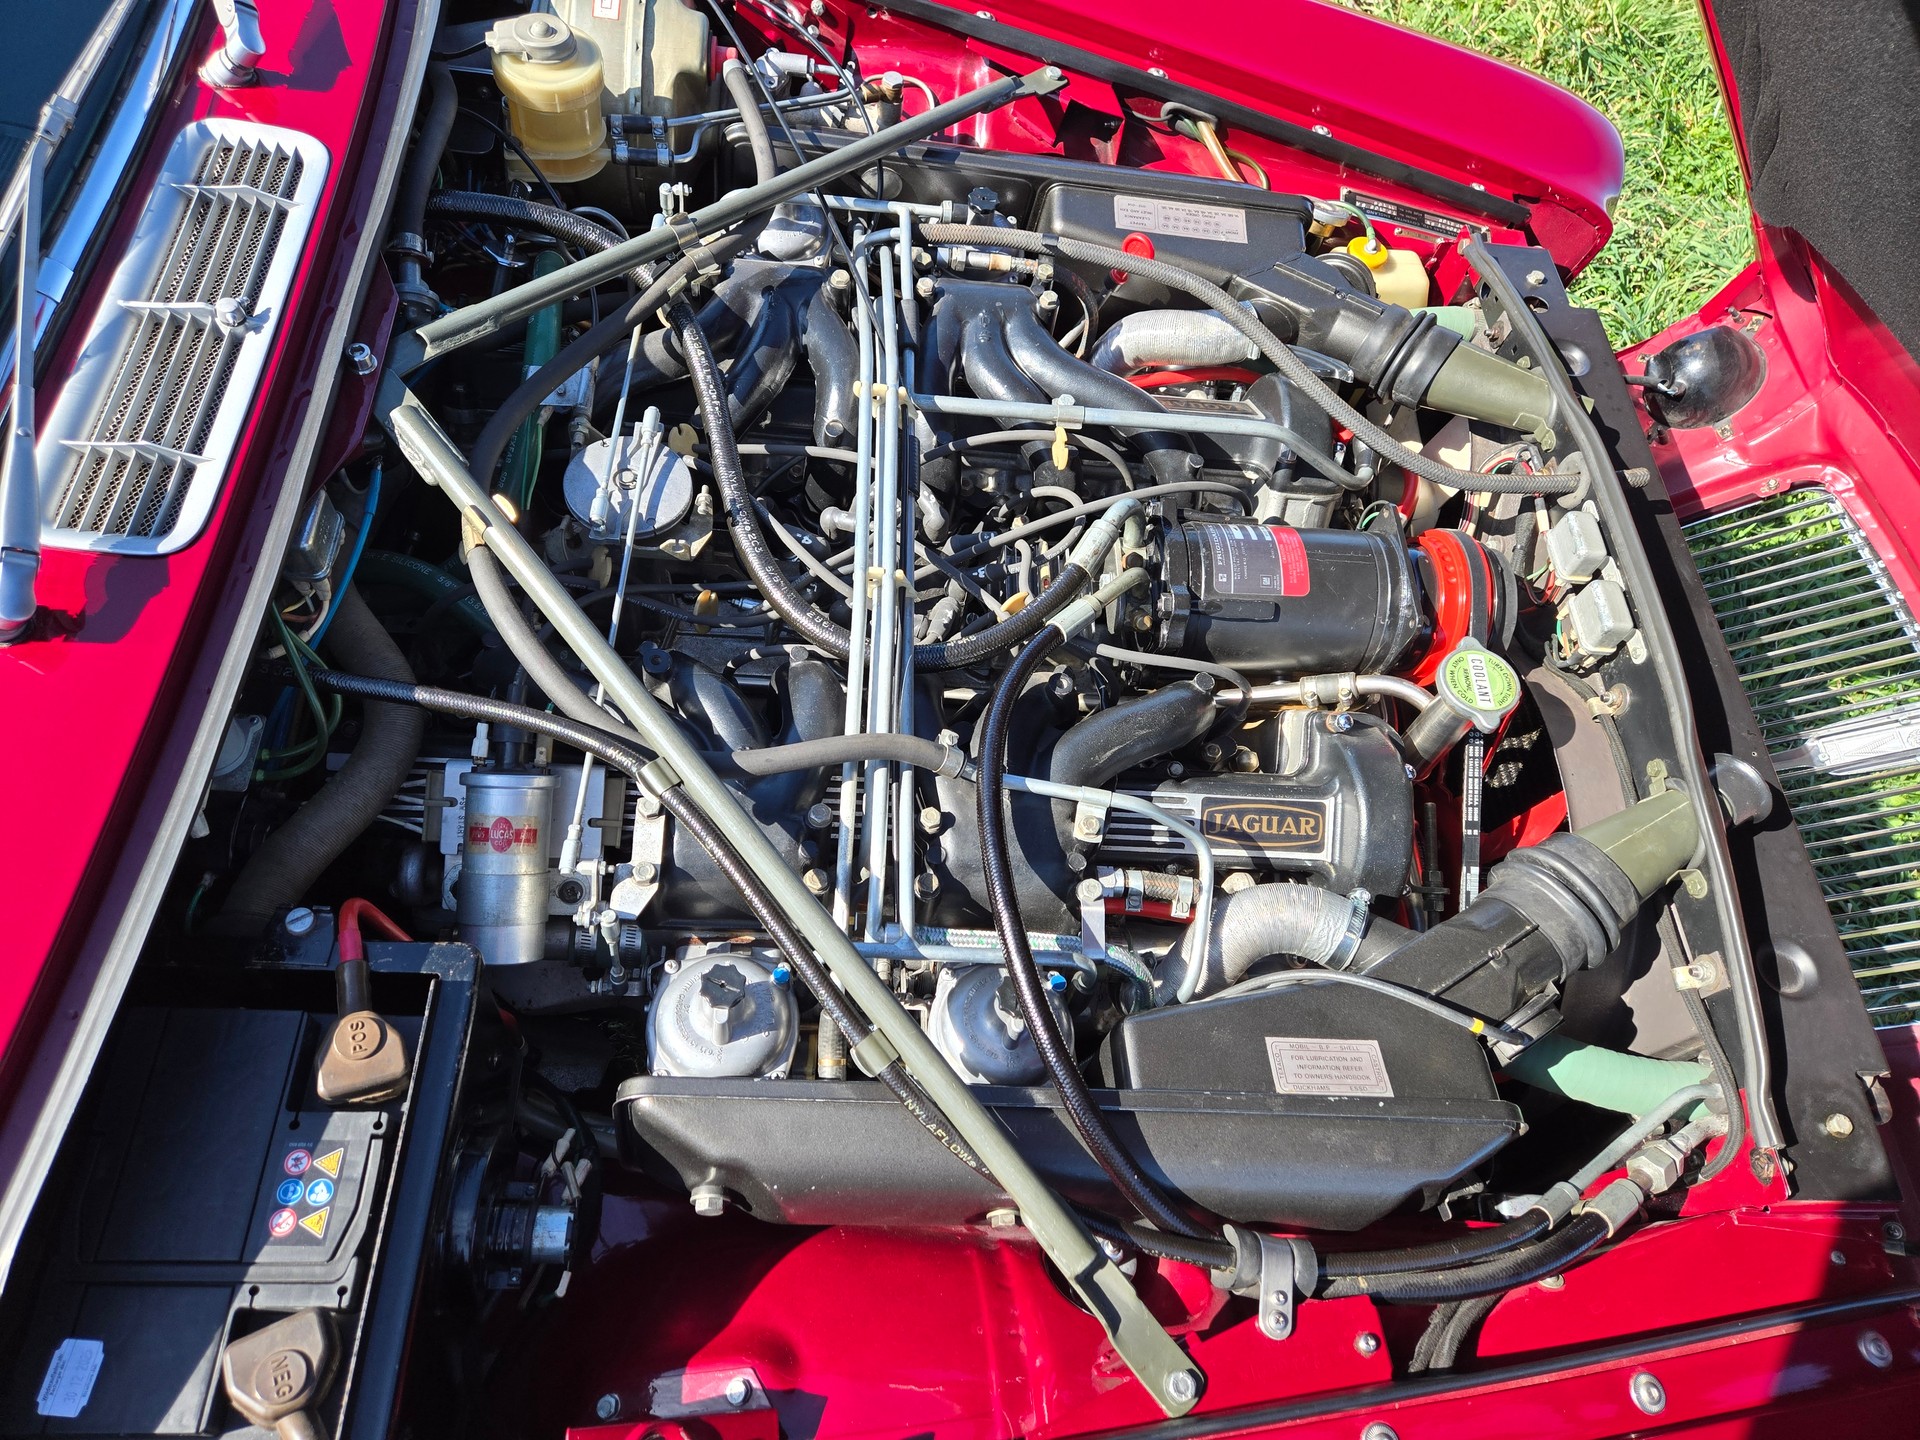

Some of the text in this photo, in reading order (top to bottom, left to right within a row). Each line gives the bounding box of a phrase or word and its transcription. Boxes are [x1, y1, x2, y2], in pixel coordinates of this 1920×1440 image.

[1366, 209, 1391, 219] ENGLAND
[390, 555, 433, 576] SILICONE
[1450, 656, 1473, 704] ONLY WHEN COLD
[1463, 668, 1472, 691] REMOVE
[1471, 659, 1491, 703] COOLANT
[1488, 658, 1512, 706] TURN DOWN TIGHT
[491, 830, 514, 839] LUCAS
[1209, 813, 1317, 836] JAGUAR
[350, 1021, 368, 1054] POS
[1275, 1053, 1284, 1079] TEXACO
[1371, 1054, 1384, 1083] CASTROL
[267, 1355, 297, 1398] NEG
